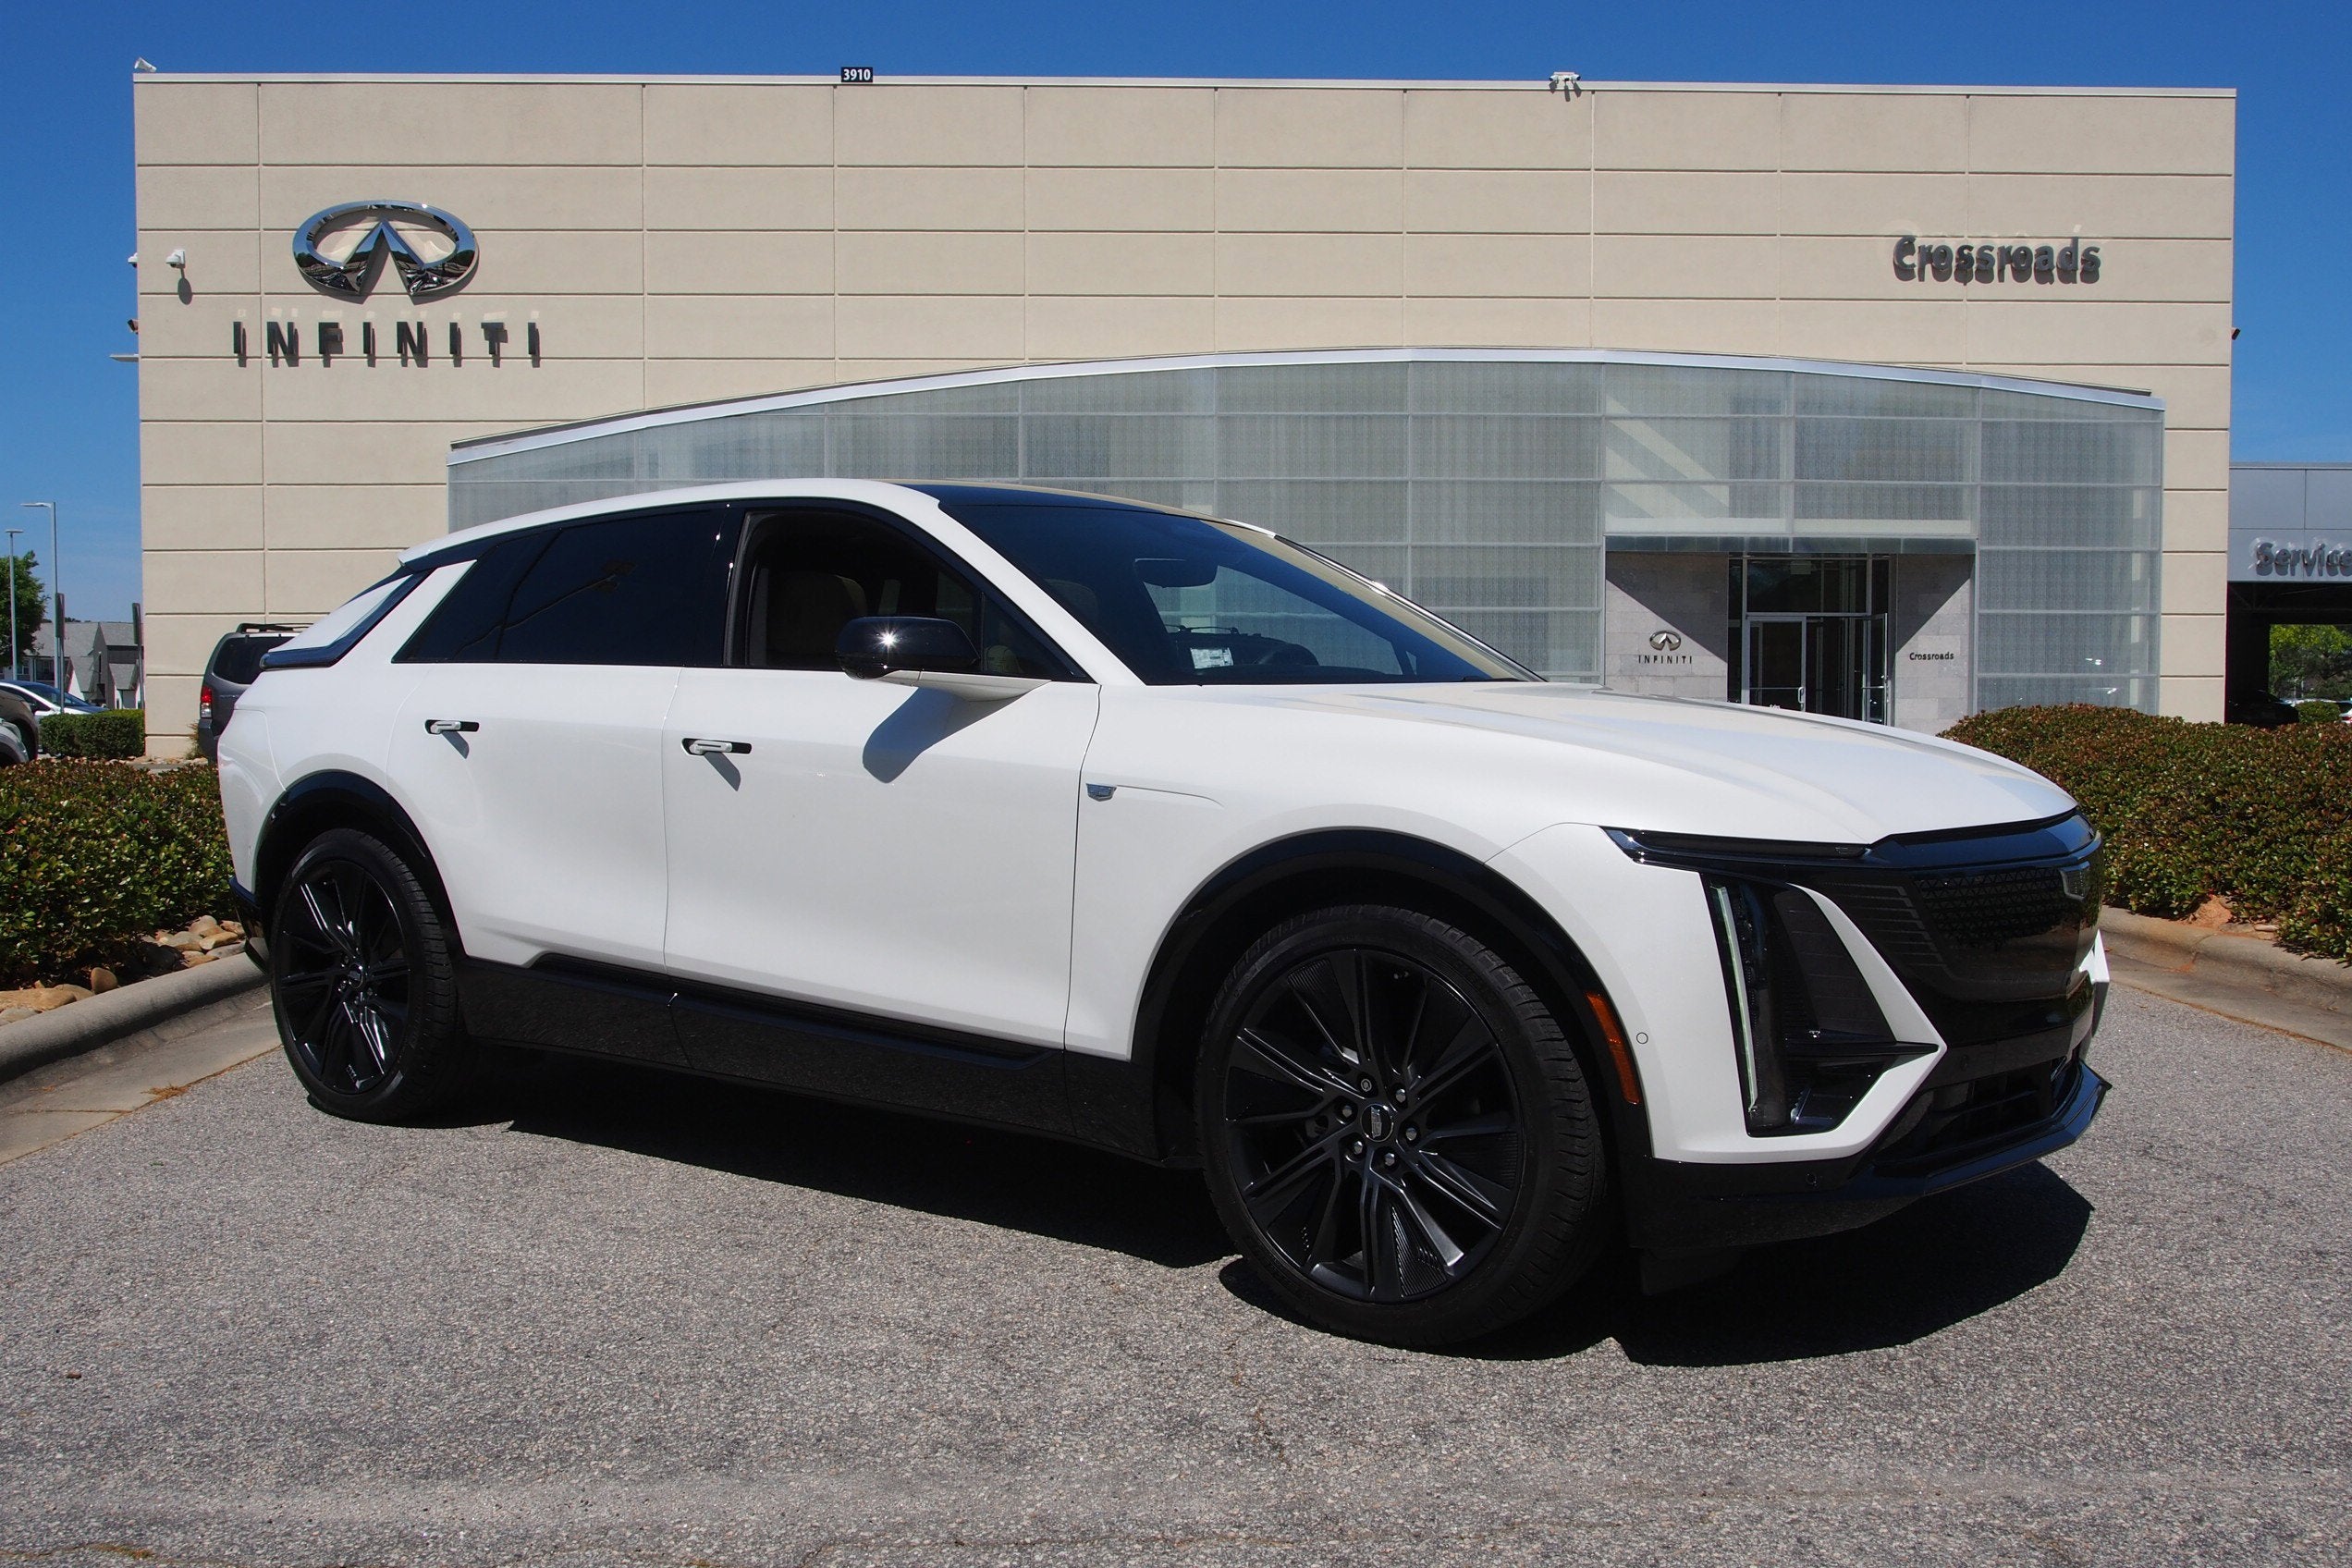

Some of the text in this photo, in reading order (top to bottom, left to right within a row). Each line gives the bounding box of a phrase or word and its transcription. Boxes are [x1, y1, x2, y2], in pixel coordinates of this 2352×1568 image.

[843, 68, 871, 80] 3910
[1893, 235, 2101, 274] Crossroads
[232, 321, 539, 359] INFINITI
[2255, 542, 2352, 569] Service
[1638, 655, 1692, 664] INFINITI
[1909, 652, 1954, 660] Crossroads
